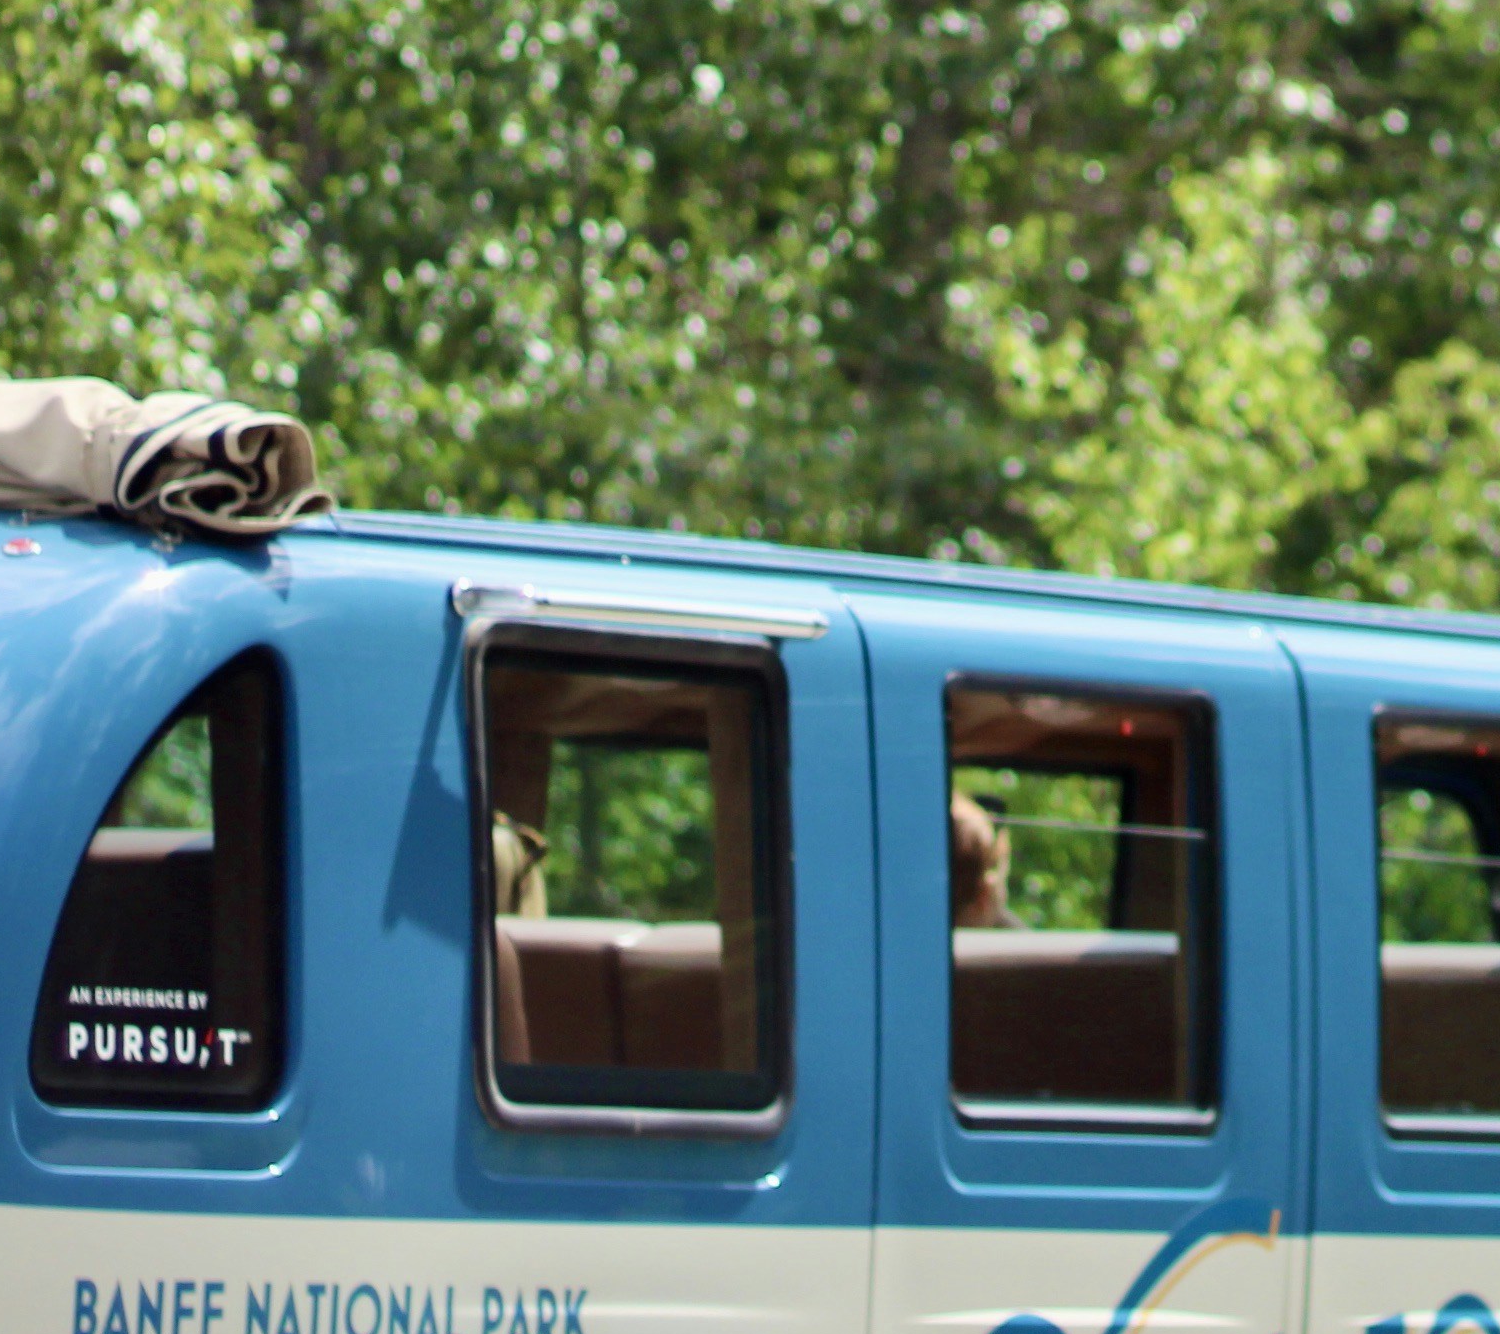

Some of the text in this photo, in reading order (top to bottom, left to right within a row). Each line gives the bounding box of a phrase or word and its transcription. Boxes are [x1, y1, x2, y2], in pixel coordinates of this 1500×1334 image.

[68, 985, 208, 1011] AN EXPERIENCE BY
